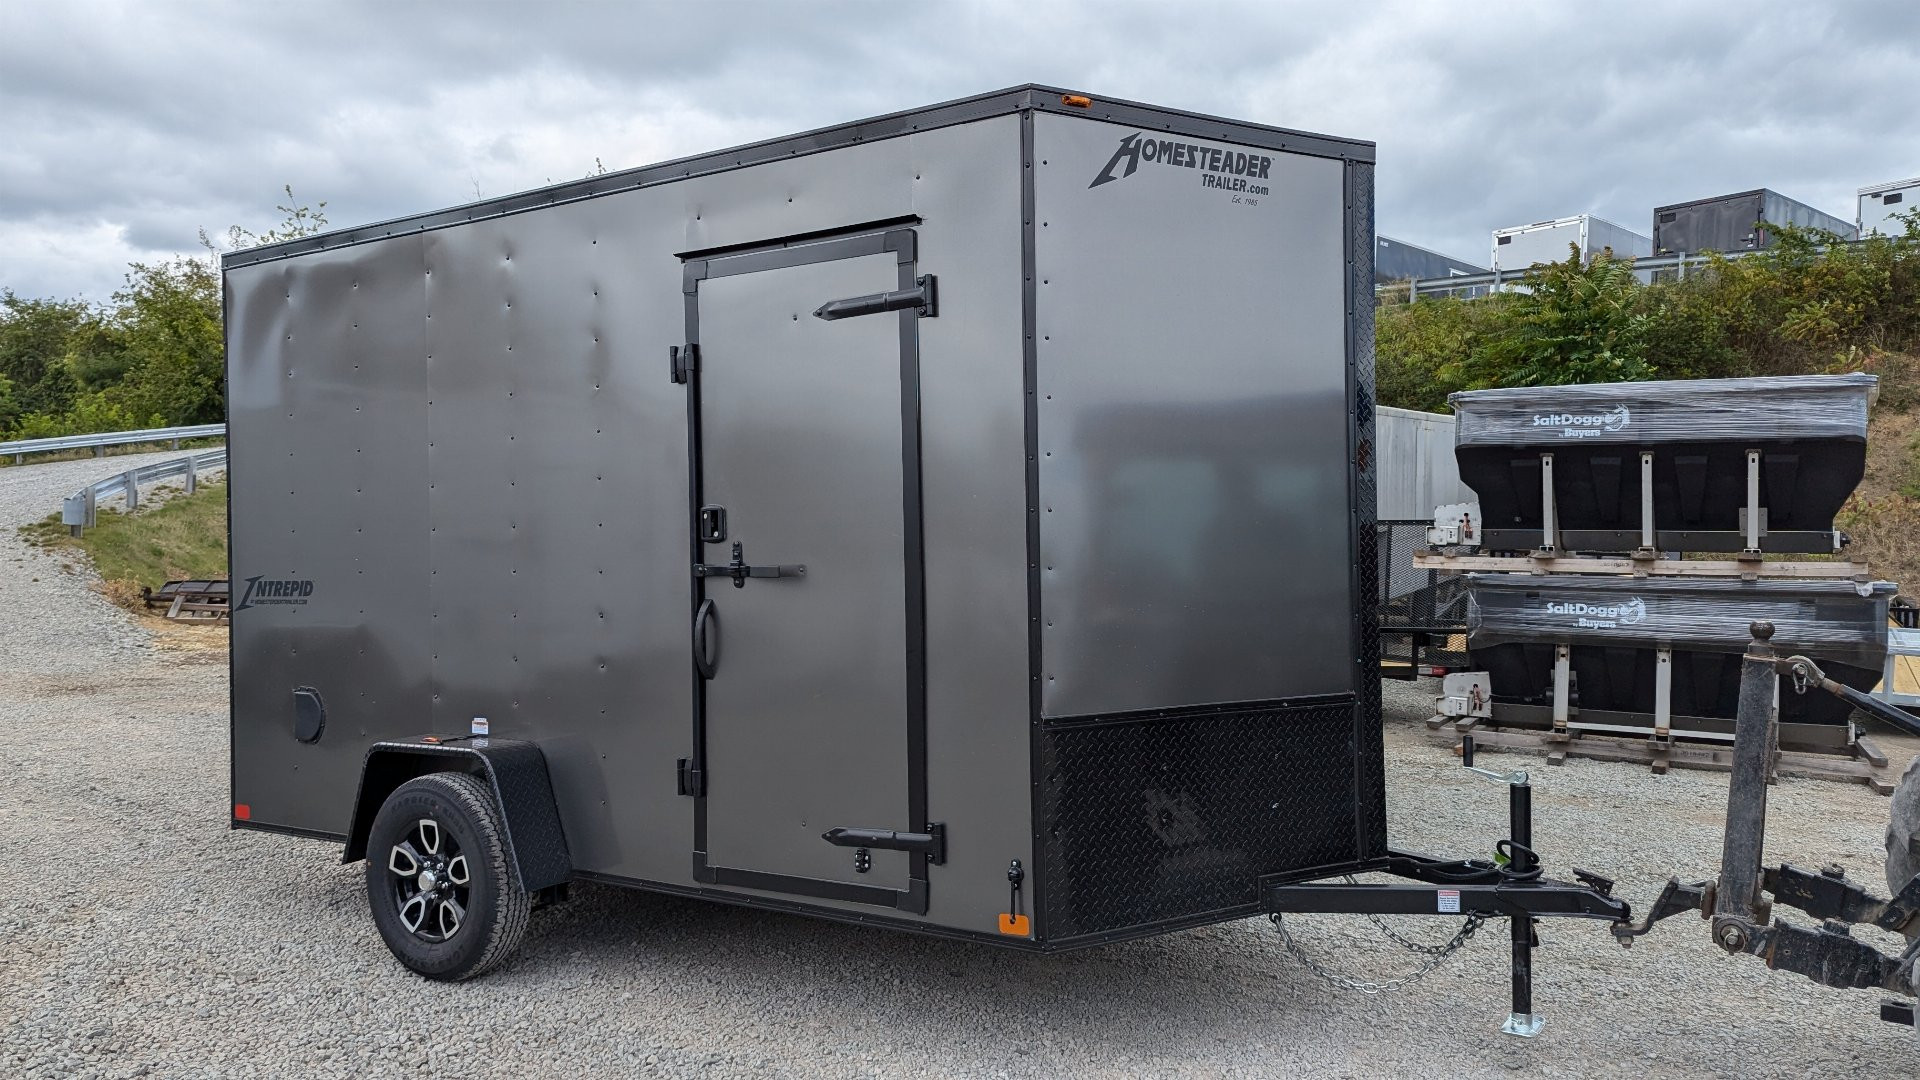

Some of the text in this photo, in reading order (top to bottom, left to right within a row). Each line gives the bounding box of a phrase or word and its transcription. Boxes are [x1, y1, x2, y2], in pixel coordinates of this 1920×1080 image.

[1088, 131, 1272, 189] HOMESTEADER
[1202, 173, 1269, 196] TRAILER.com
[1533, 413, 1602, 426] SaltDogg
[1564, 428, 1601, 438] Buyers
[234, 574, 314, 612] INTREPID
[1546, 602, 1618, 617] SaltDogg
[1578, 618, 1617, 629] Buyers
